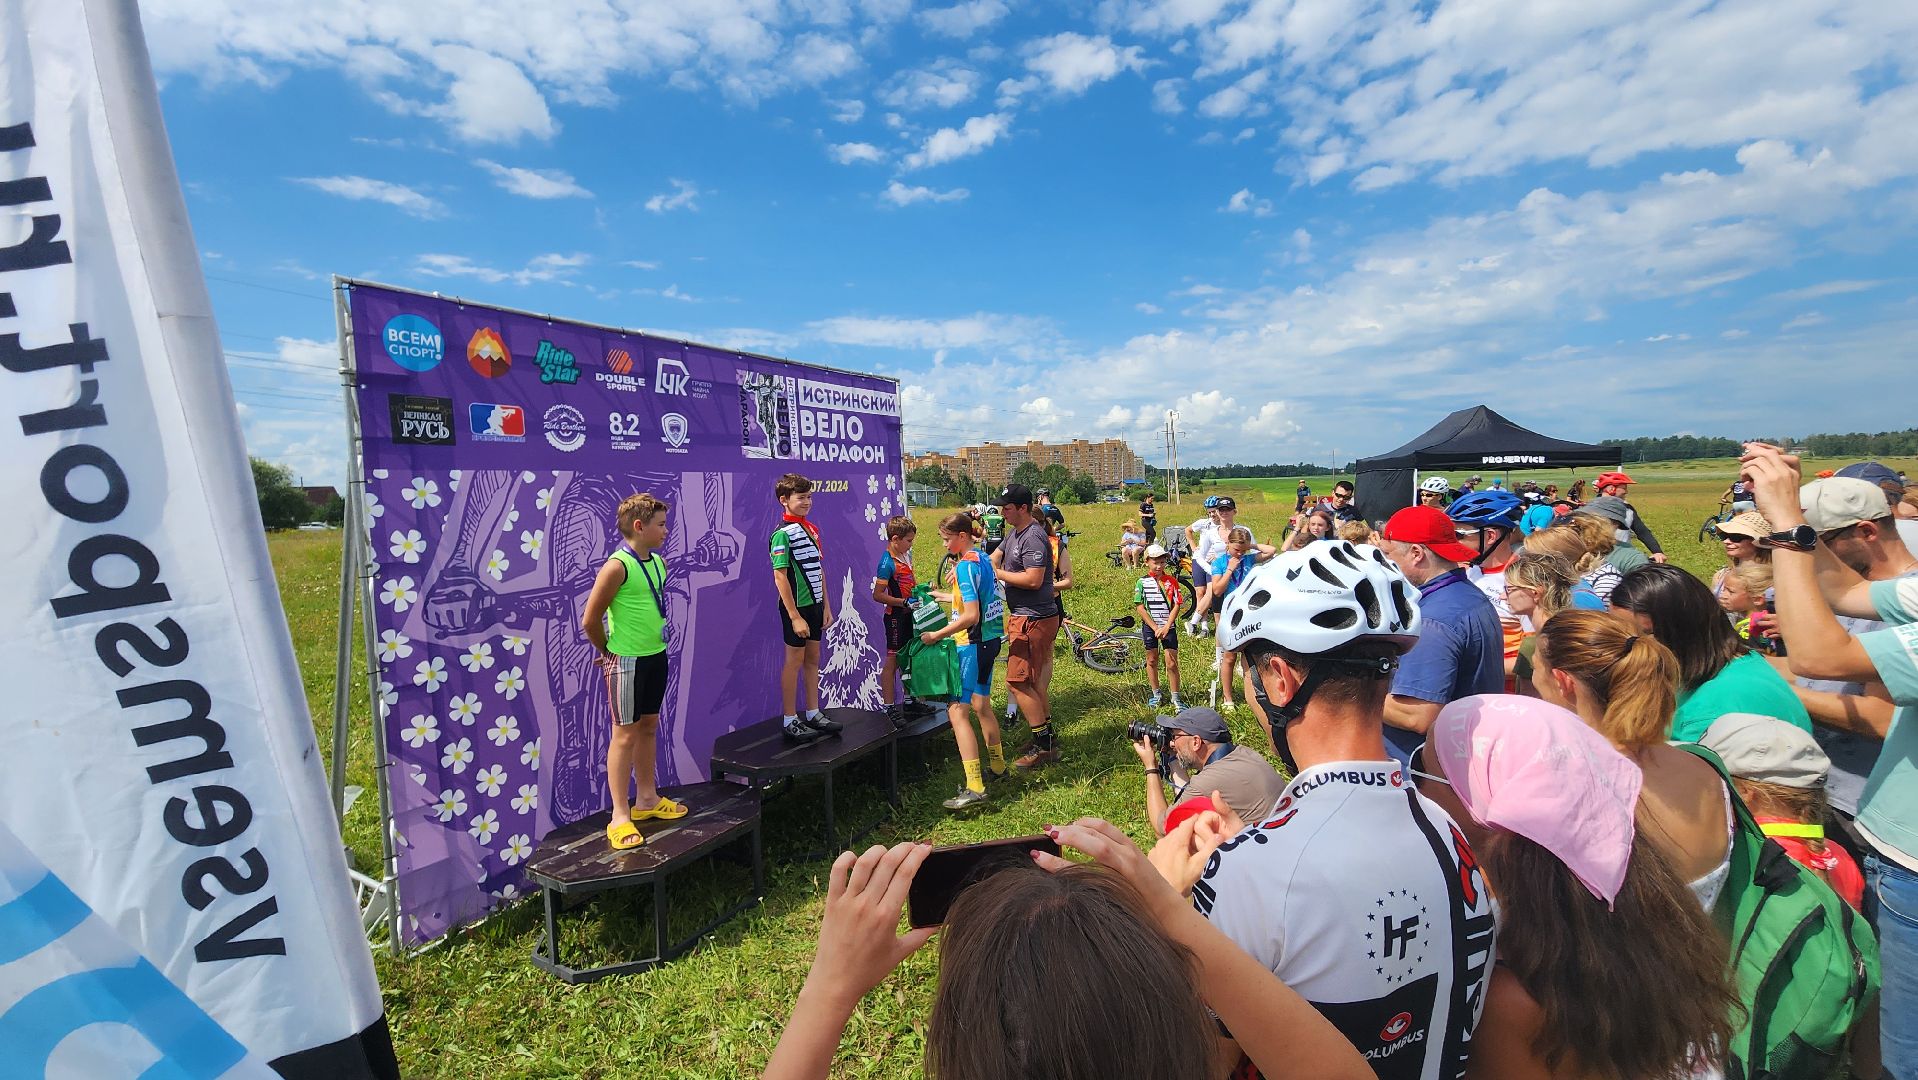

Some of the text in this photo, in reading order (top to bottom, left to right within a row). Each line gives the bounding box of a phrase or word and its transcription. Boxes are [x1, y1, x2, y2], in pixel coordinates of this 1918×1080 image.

[388, 328, 435, 347] ВСЕМ
[535, 340, 575, 367] Ride
[595, 372, 646, 387] DOUBLE
[606, 382, 637, 392] SPORTS
[802, 385, 896, 413] ИСТРИНСКИЙ
[609, 412, 640, 436] 8.2
[776, 397, 791, 456] ВЕЛО
[787, 379, 799, 447] ИСТРИНСКИЙ
[801, 409, 864, 442] ВЕЛО
[401, 420, 450, 439] РУСЬ
[802, 441, 885, 464] МАРАФОН
[1234, 621, 1262, 642] catlike
[1291, 771, 1387, 799] COLUMBUS
[1383, 914, 1420, 961] HF
[1360, 1028, 1425, 1061] OLUMBUS
